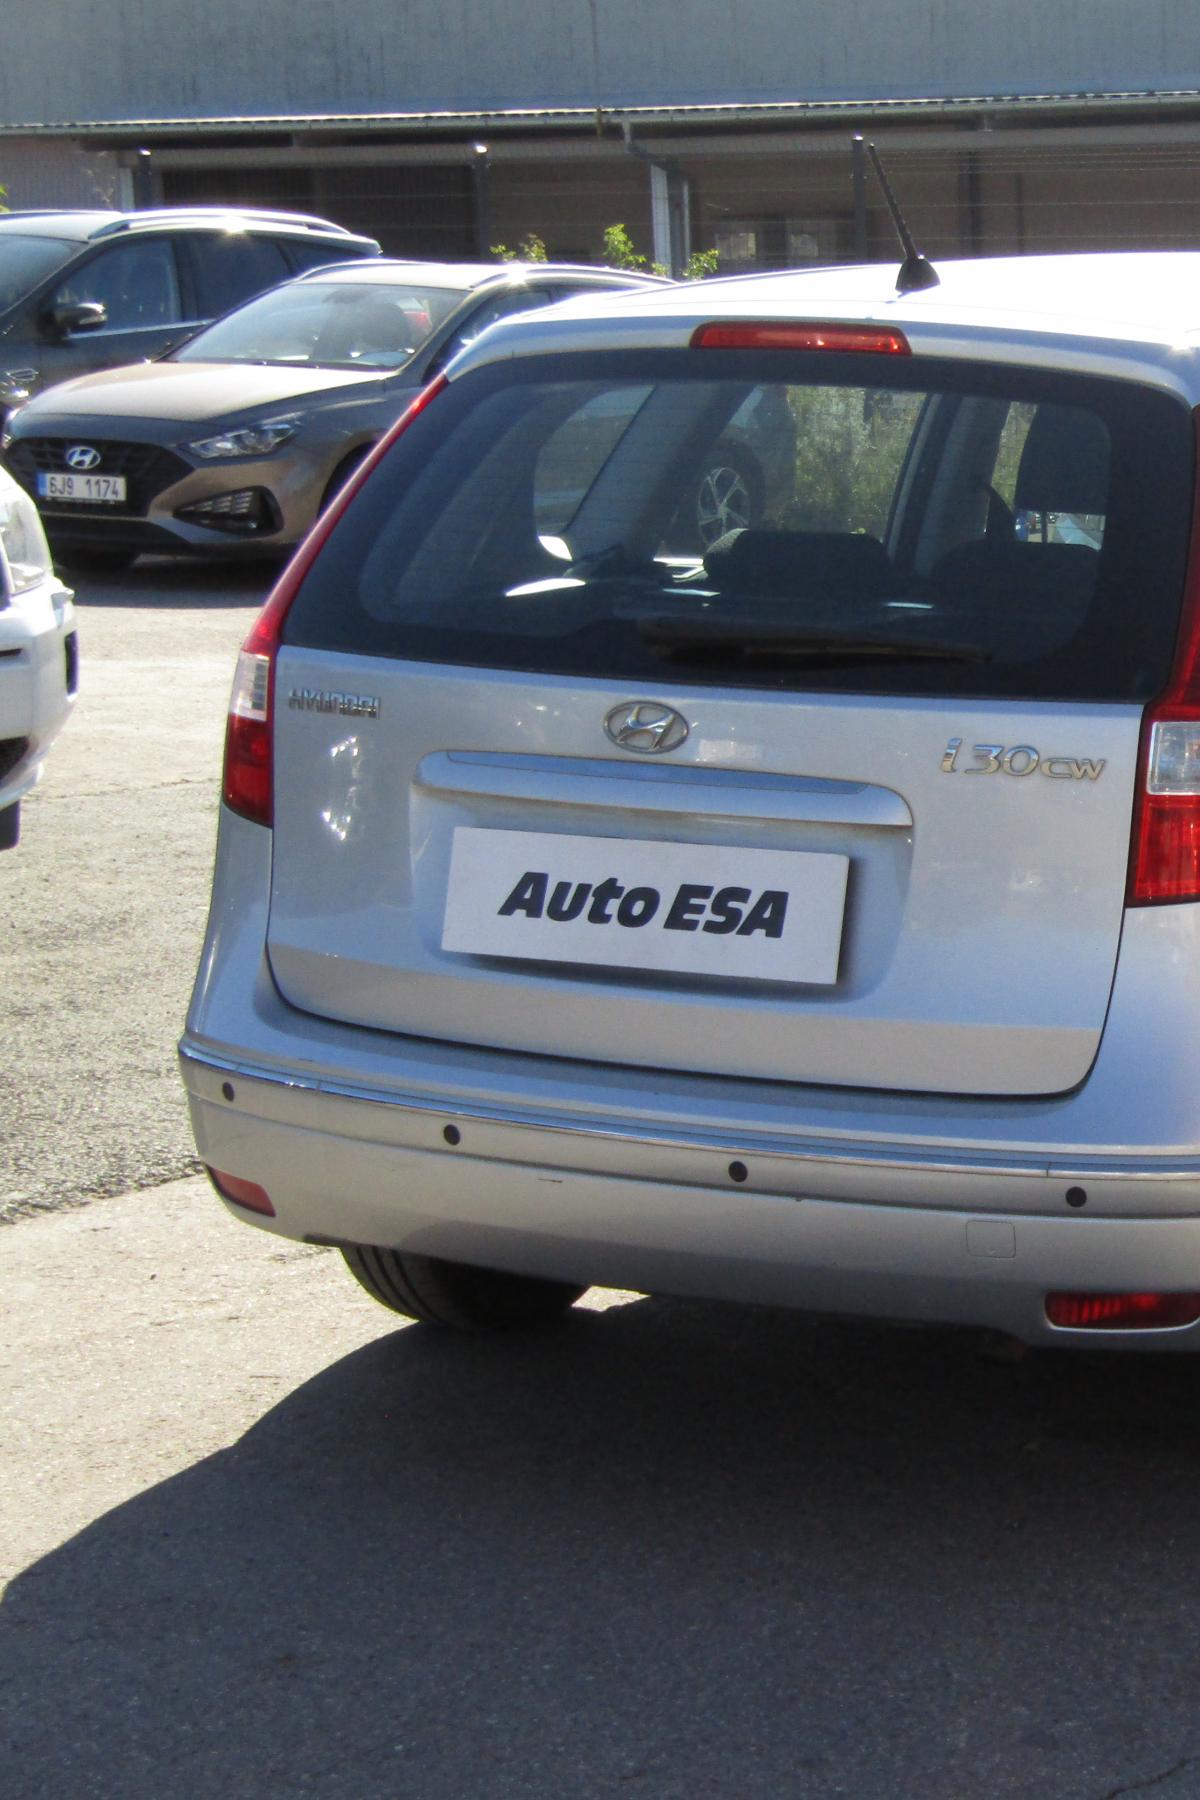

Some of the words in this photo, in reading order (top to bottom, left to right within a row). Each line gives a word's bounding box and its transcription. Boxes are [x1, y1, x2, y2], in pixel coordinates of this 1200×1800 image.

[49, 476, 74, 496] 6J9
[85, 478, 120, 498] 1174
[497, 871, 661, 928] Auto
[663, 884, 790, 939] ESA
